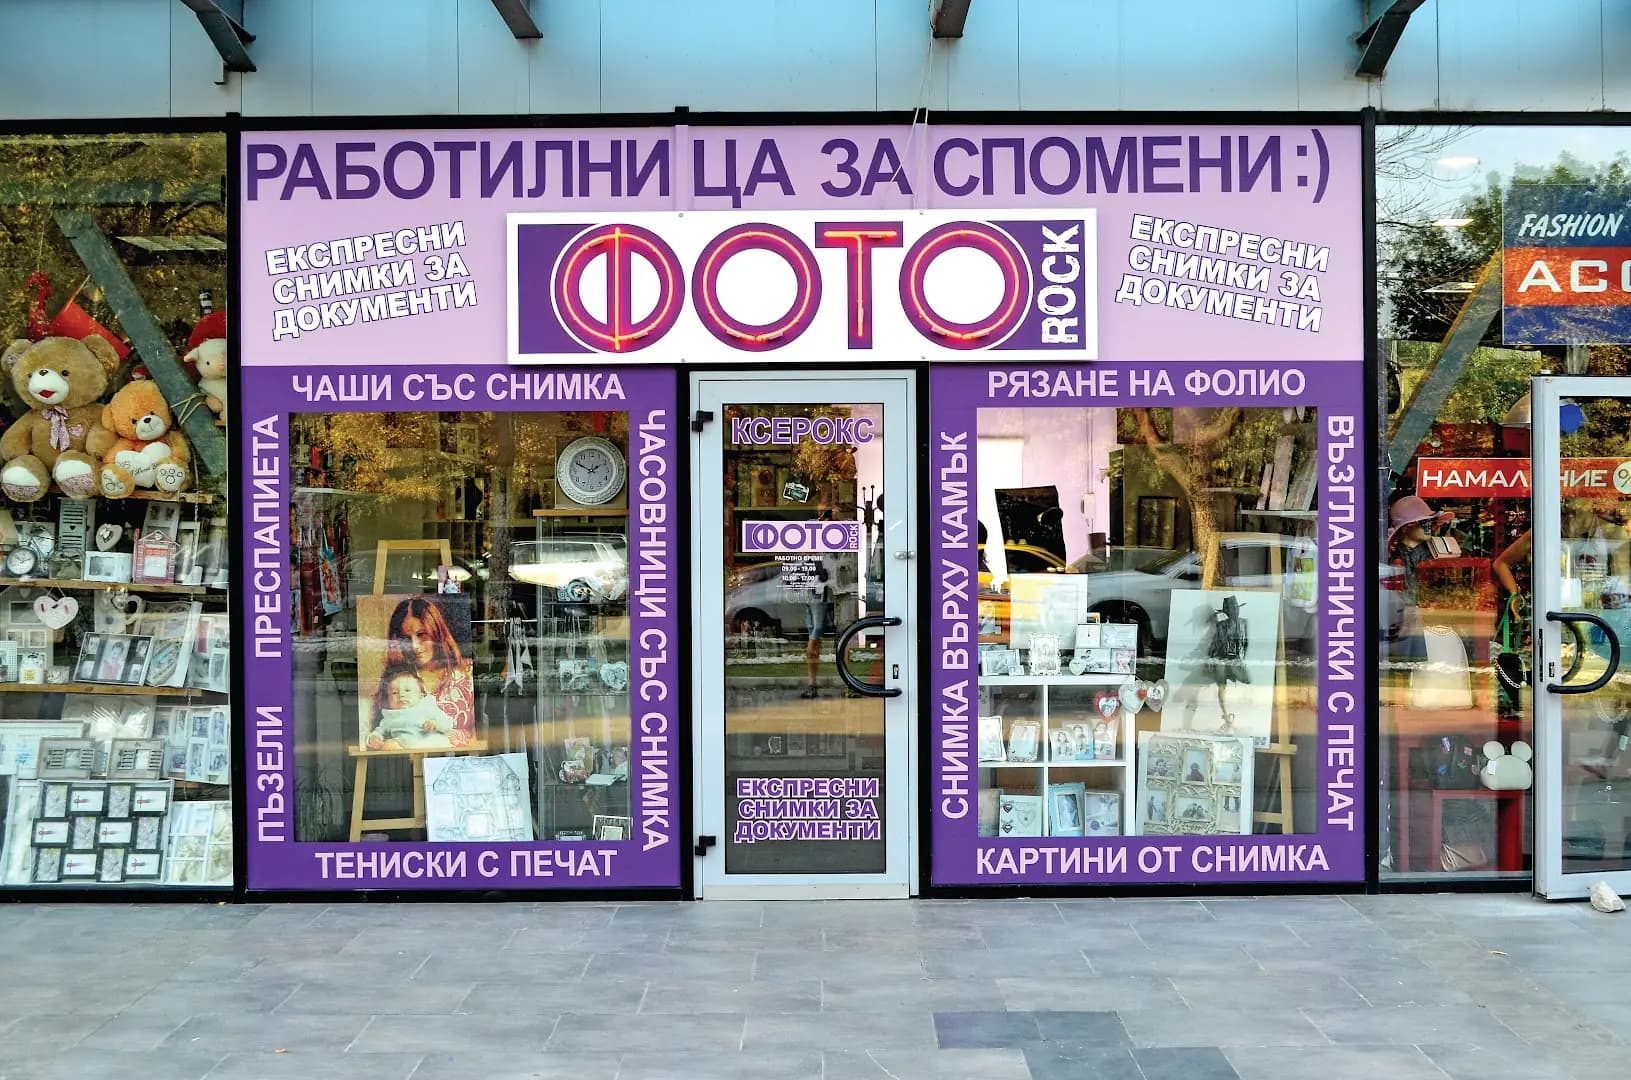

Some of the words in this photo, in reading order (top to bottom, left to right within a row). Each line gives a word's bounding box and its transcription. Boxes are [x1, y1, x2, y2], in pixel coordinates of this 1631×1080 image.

[820, 137, 914, 198] ЗА
[264, 220, 467, 276] ЕКСПРЕСНИ
[1129, 213, 1331, 273] ЕКСПРЕСНИ
[1518, 212, 1624, 238] FASHION
[271, 256, 416, 306] СНИМКИ
[424, 253, 470, 284] ЗА
[553, 221, 1030, 353] ФОТО
[1037, 224, 1081, 345] ROCK
[1114, 273, 1323, 333] ДОКУМЕНТИ
[1128, 245, 1271, 293] СНИМКИ
[1278, 270, 1322, 303] ЗА
[1517, 260, 1631, 293] AC
[271, 280, 478, 341] ДОКУМЕНТИ
[292, 374, 391, 402] ЧАШИ
[403, 373, 476, 401] СЪС
[485, 372, 626, 401] СНИМКА
[988, 369, 1119, 398] РЯЗАНЕ
[1129, 369, 1175, 397] НА
[1184, 368, 1306, 396] ФОЛИО
[731, 417, 874, 445] КСЕРОКС
[941, 431, 969, 549] КАМЪК
[1422, 469, 1608, 488] НАМАЛНИЕ
[252, 414, 282, 659] ПРЕСПАПИЕТА
[635, 409, 667, 618] ЧАСОВНИЦИ
[752, 523, 849, 550] ФОТО
[849, 524, 859, 550] ROCK
[1327, 415, 1355, 680] ВЪЗГЛАВНИЧКИ
[942, 559, 970, 671] ВЪРХУ
[639, 629, 668, 702] СЪС
[1327, 690, 1355, 714] С
[257, 705, 286, 843] ПЪЗЕЛИ
[942, 679, 969, 820] СНИМКА
[1327, 724, 1355, 831] ПЕЧАТ
[639, 711, 670, 852] СНИМКА
[736, 778, 880, 798] ЕКСПРЕСНИ
[738, 799, 840, 819] СНИМКИ
[845, 799, 879, 819] ЗА
[734, 820, 881, 843] ДОКУМЕНТИ
[976, 847, 1128, 876] КАРТИНИ
[1138, 845, 1183, 874] ОТ
[1191, 844, 1330, 874] СНИМКА
[315, 851, 467, 880] ТЕНИСКИ
[477, 851, 500, 879] С
[510, 849, 618, 878] ПЕЧАТ
